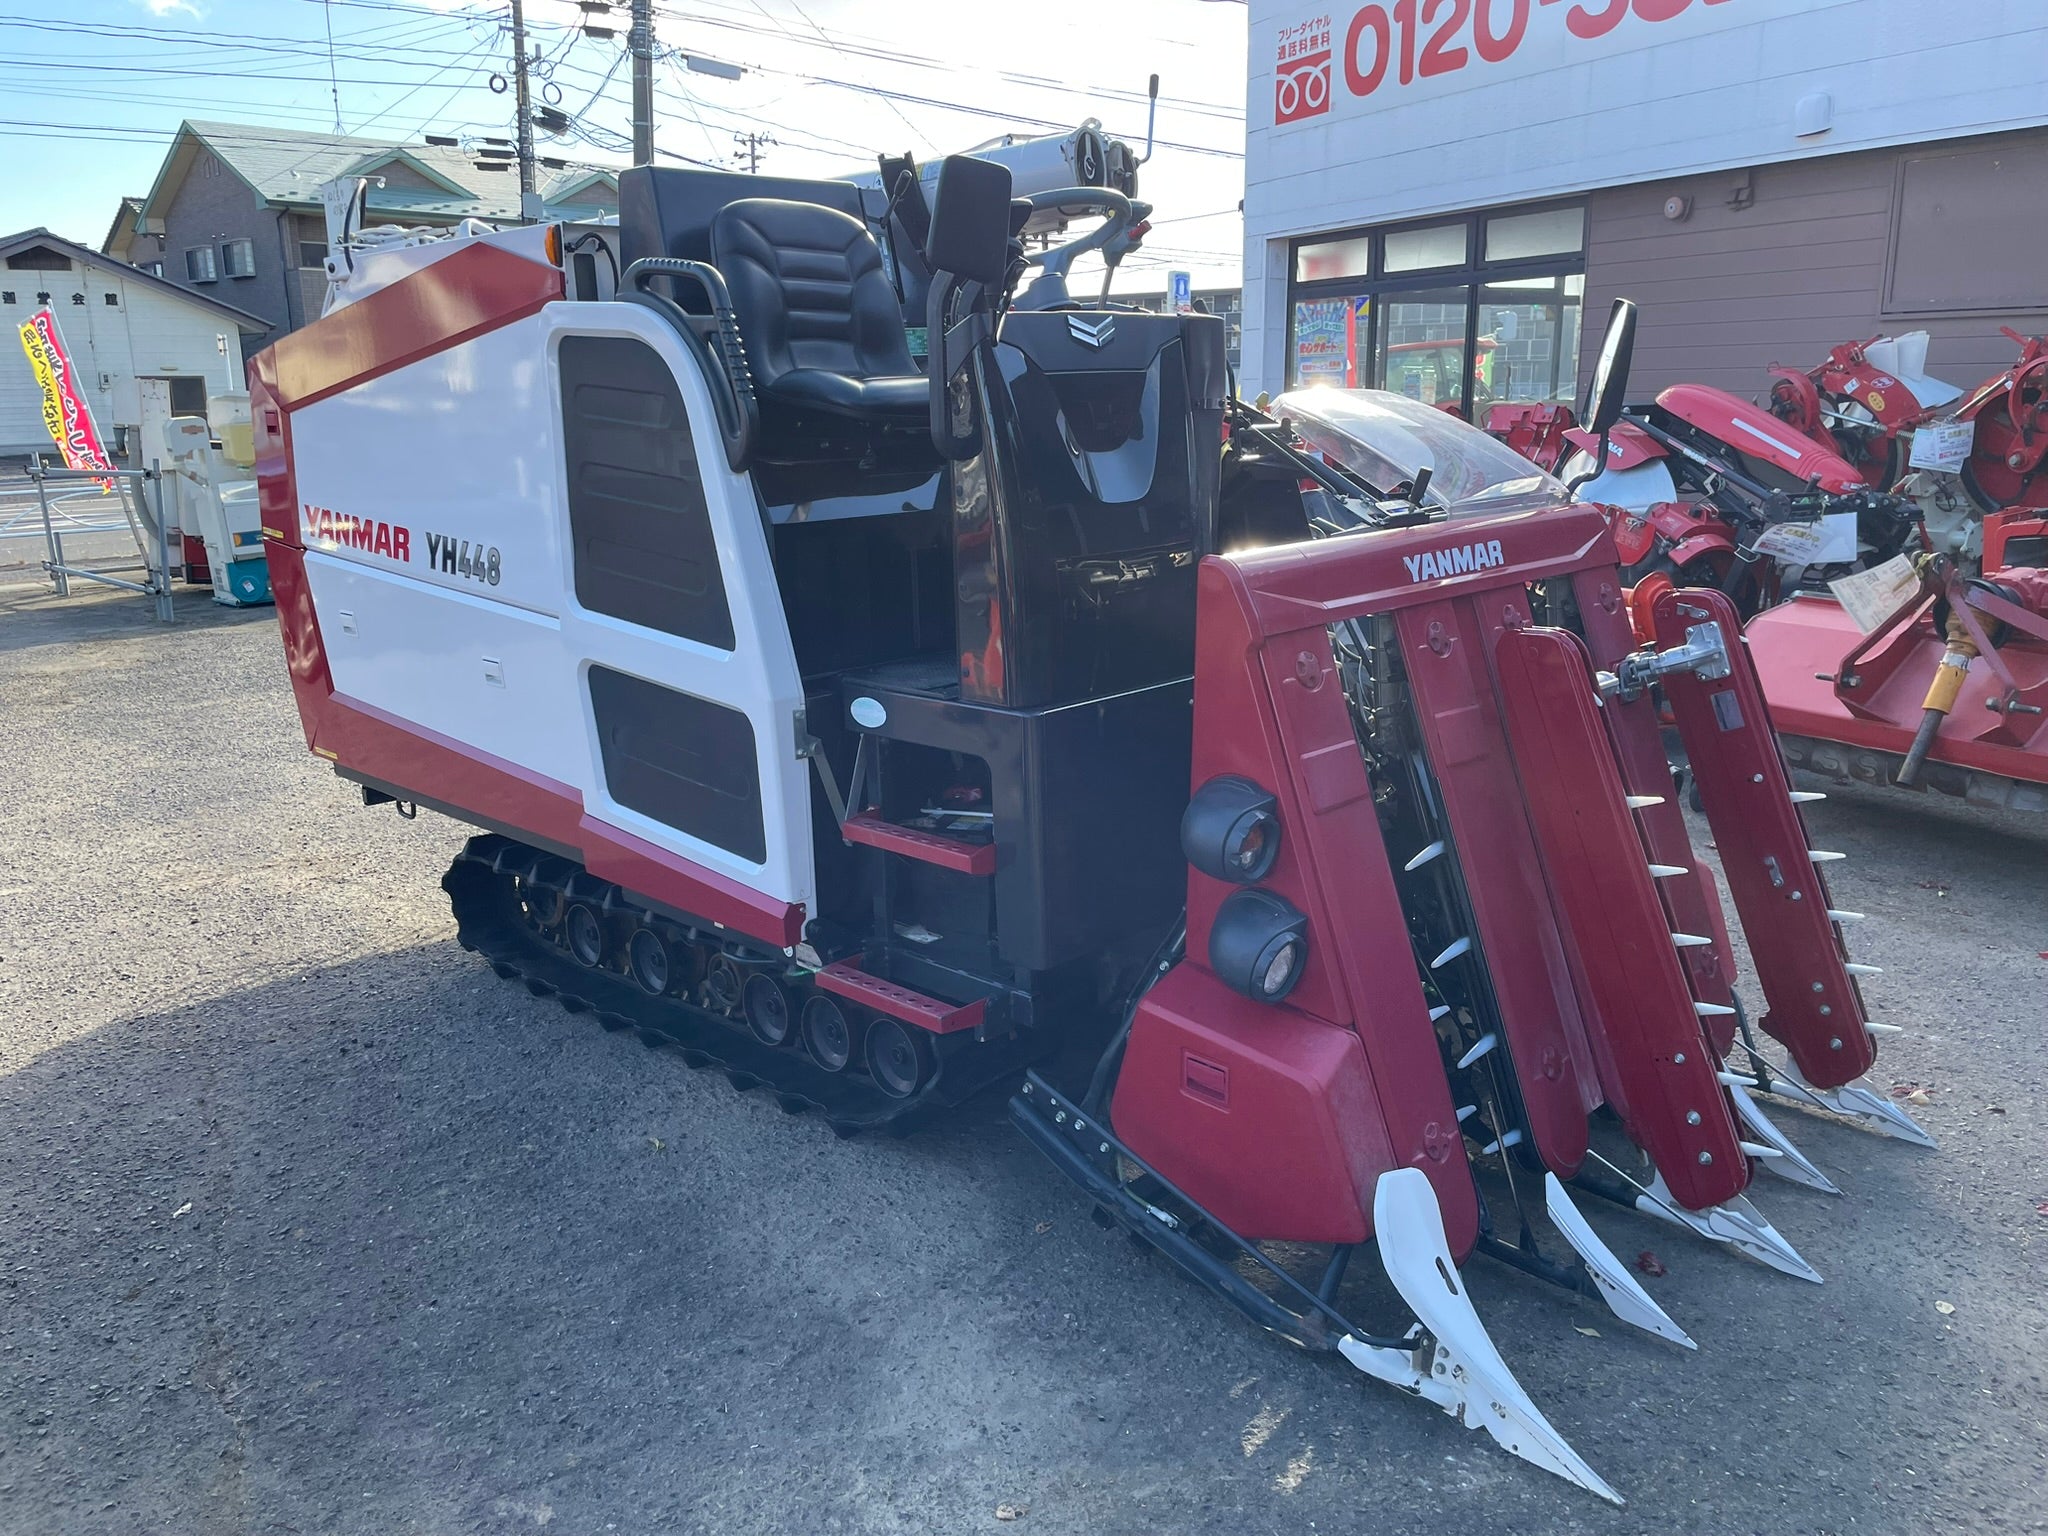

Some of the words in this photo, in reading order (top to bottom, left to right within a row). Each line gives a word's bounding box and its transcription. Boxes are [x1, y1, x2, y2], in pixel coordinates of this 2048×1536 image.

[1277, 30, 1330, 60] 通話料無料
[1278, 14, 1332, 42] フリーダイヤル
[1344, 0, 1732, 96] 0120
[304, 504, 410, 563] YANMAR
[425, 532, 501, 586] YH448
[1403, 540, 1504, 583] YANMAR
